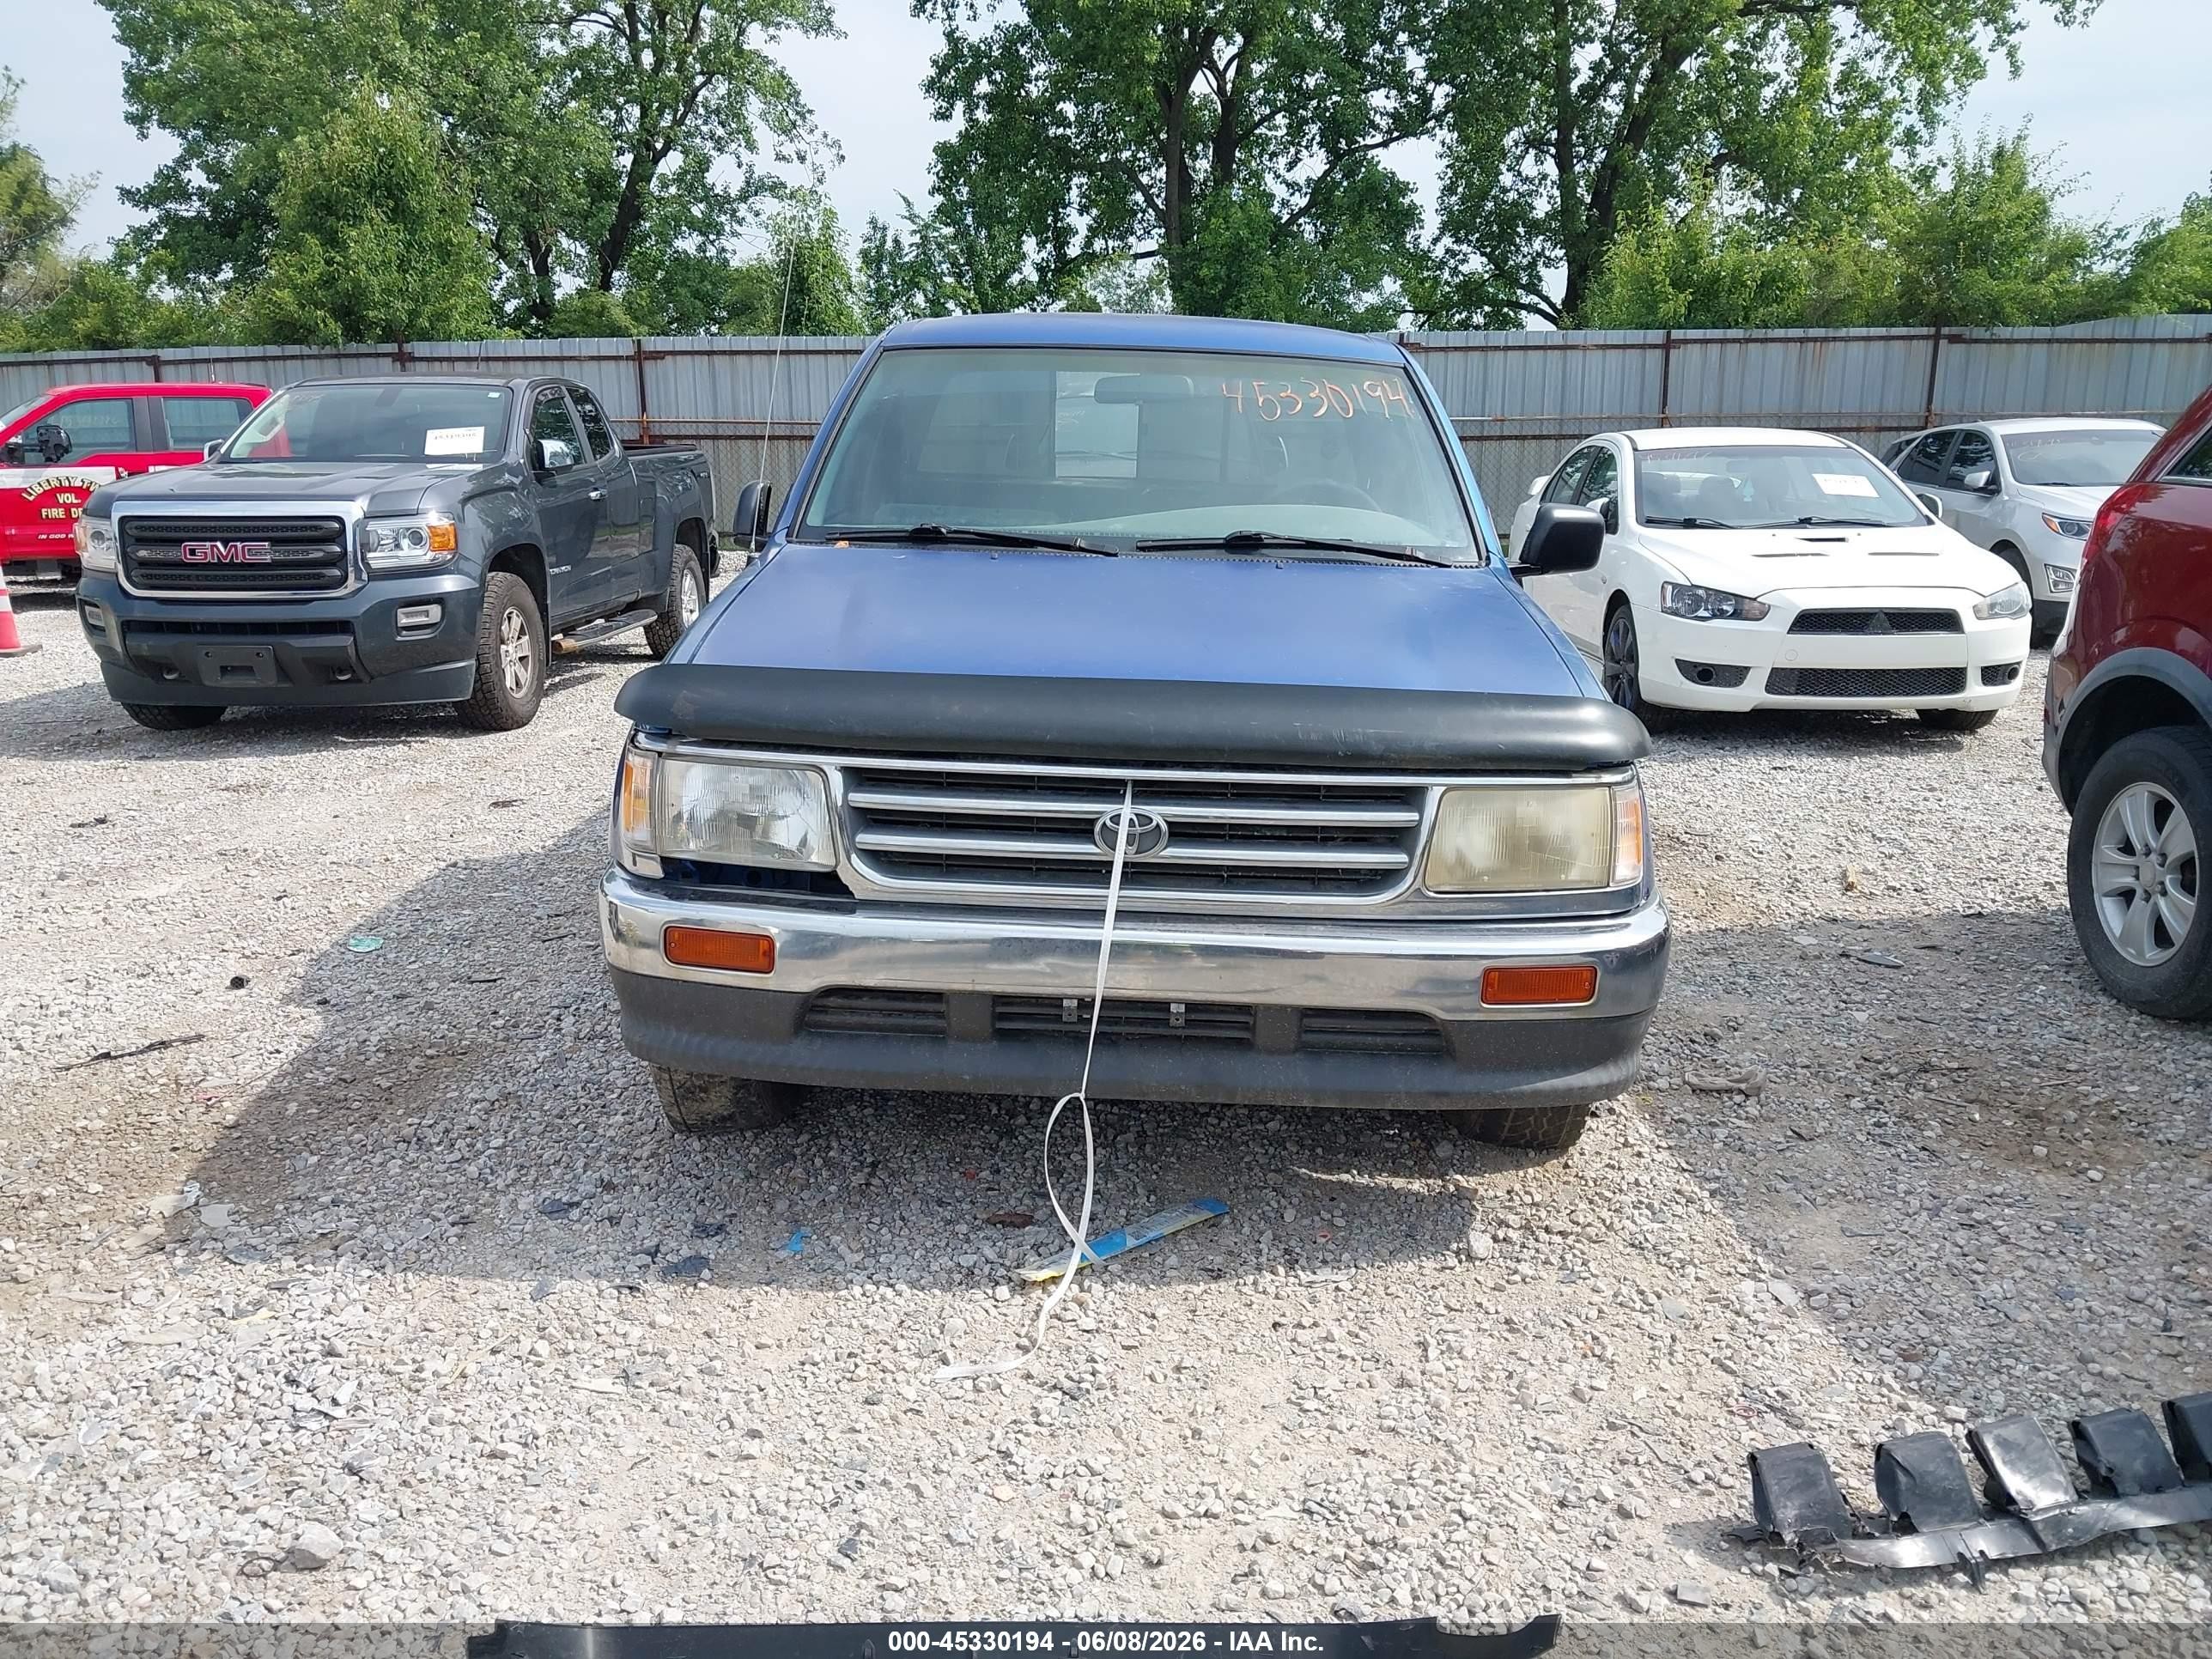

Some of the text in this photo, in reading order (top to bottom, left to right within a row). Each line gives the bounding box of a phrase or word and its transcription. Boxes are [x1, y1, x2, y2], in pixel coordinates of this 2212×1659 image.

[1222, 378, 1416, 421] 45330194
[21, 477, 77, 501] LIBERTY
[56, 493, 82, 504] VOL.
[41, 507, 66, 519] FIRE
[181, 541, 271, 562] GMC
